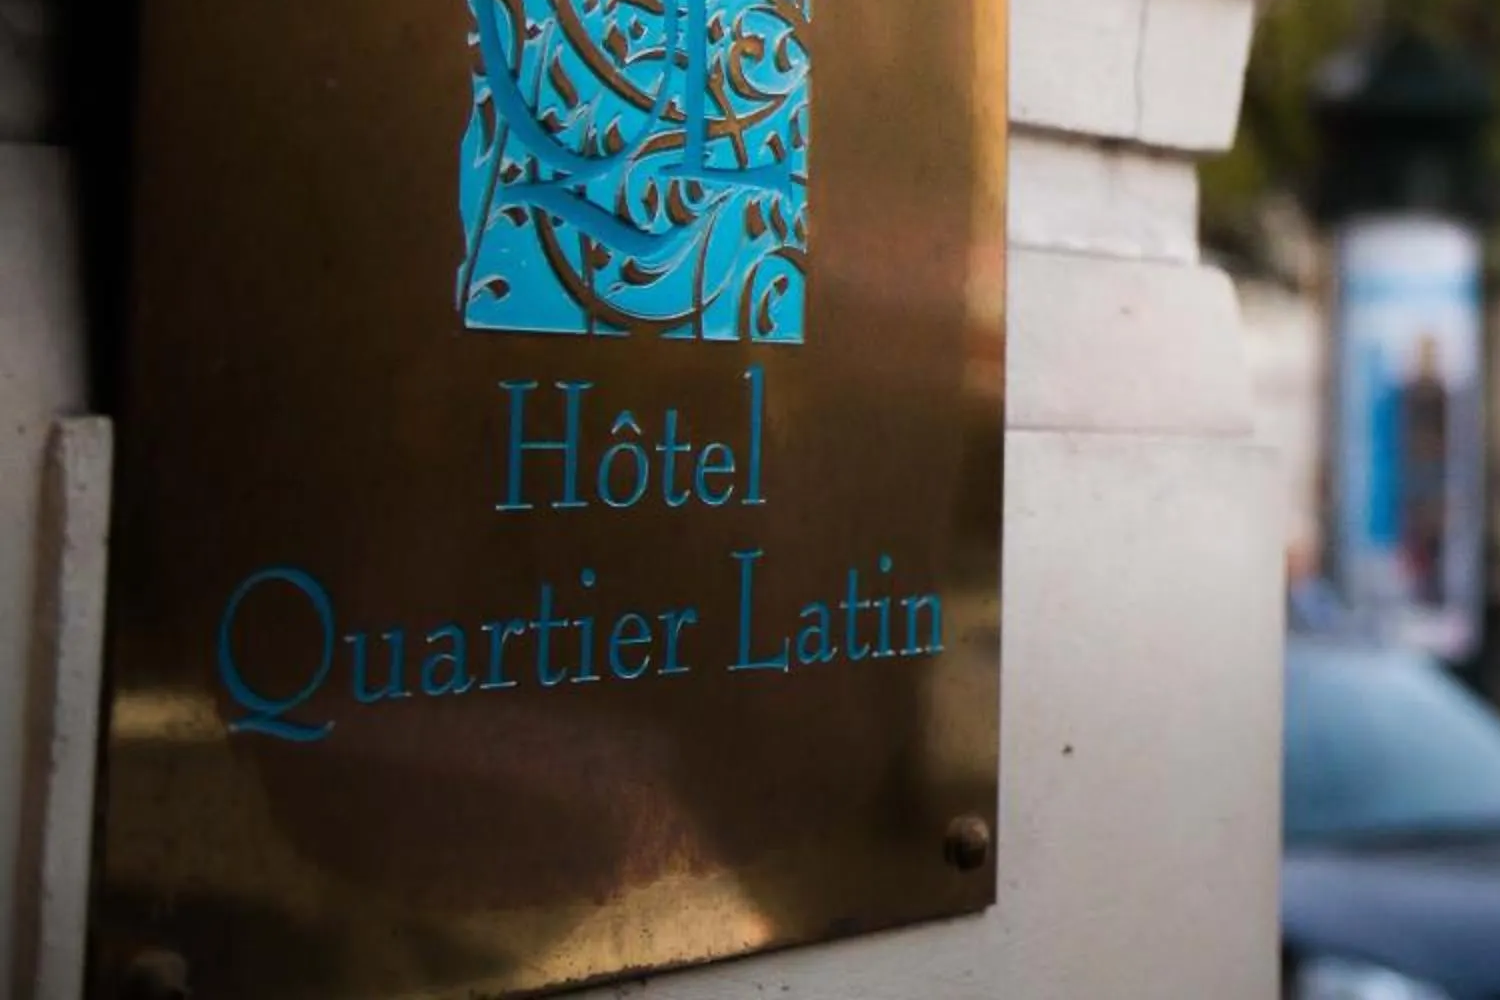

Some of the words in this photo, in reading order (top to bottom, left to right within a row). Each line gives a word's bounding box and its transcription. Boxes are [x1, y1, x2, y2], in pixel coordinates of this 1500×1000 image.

[495, 362, 767, 511] Hôtel
[216, 565, 699, 743] Quartier
[727, 548, 945, 673] Latin
